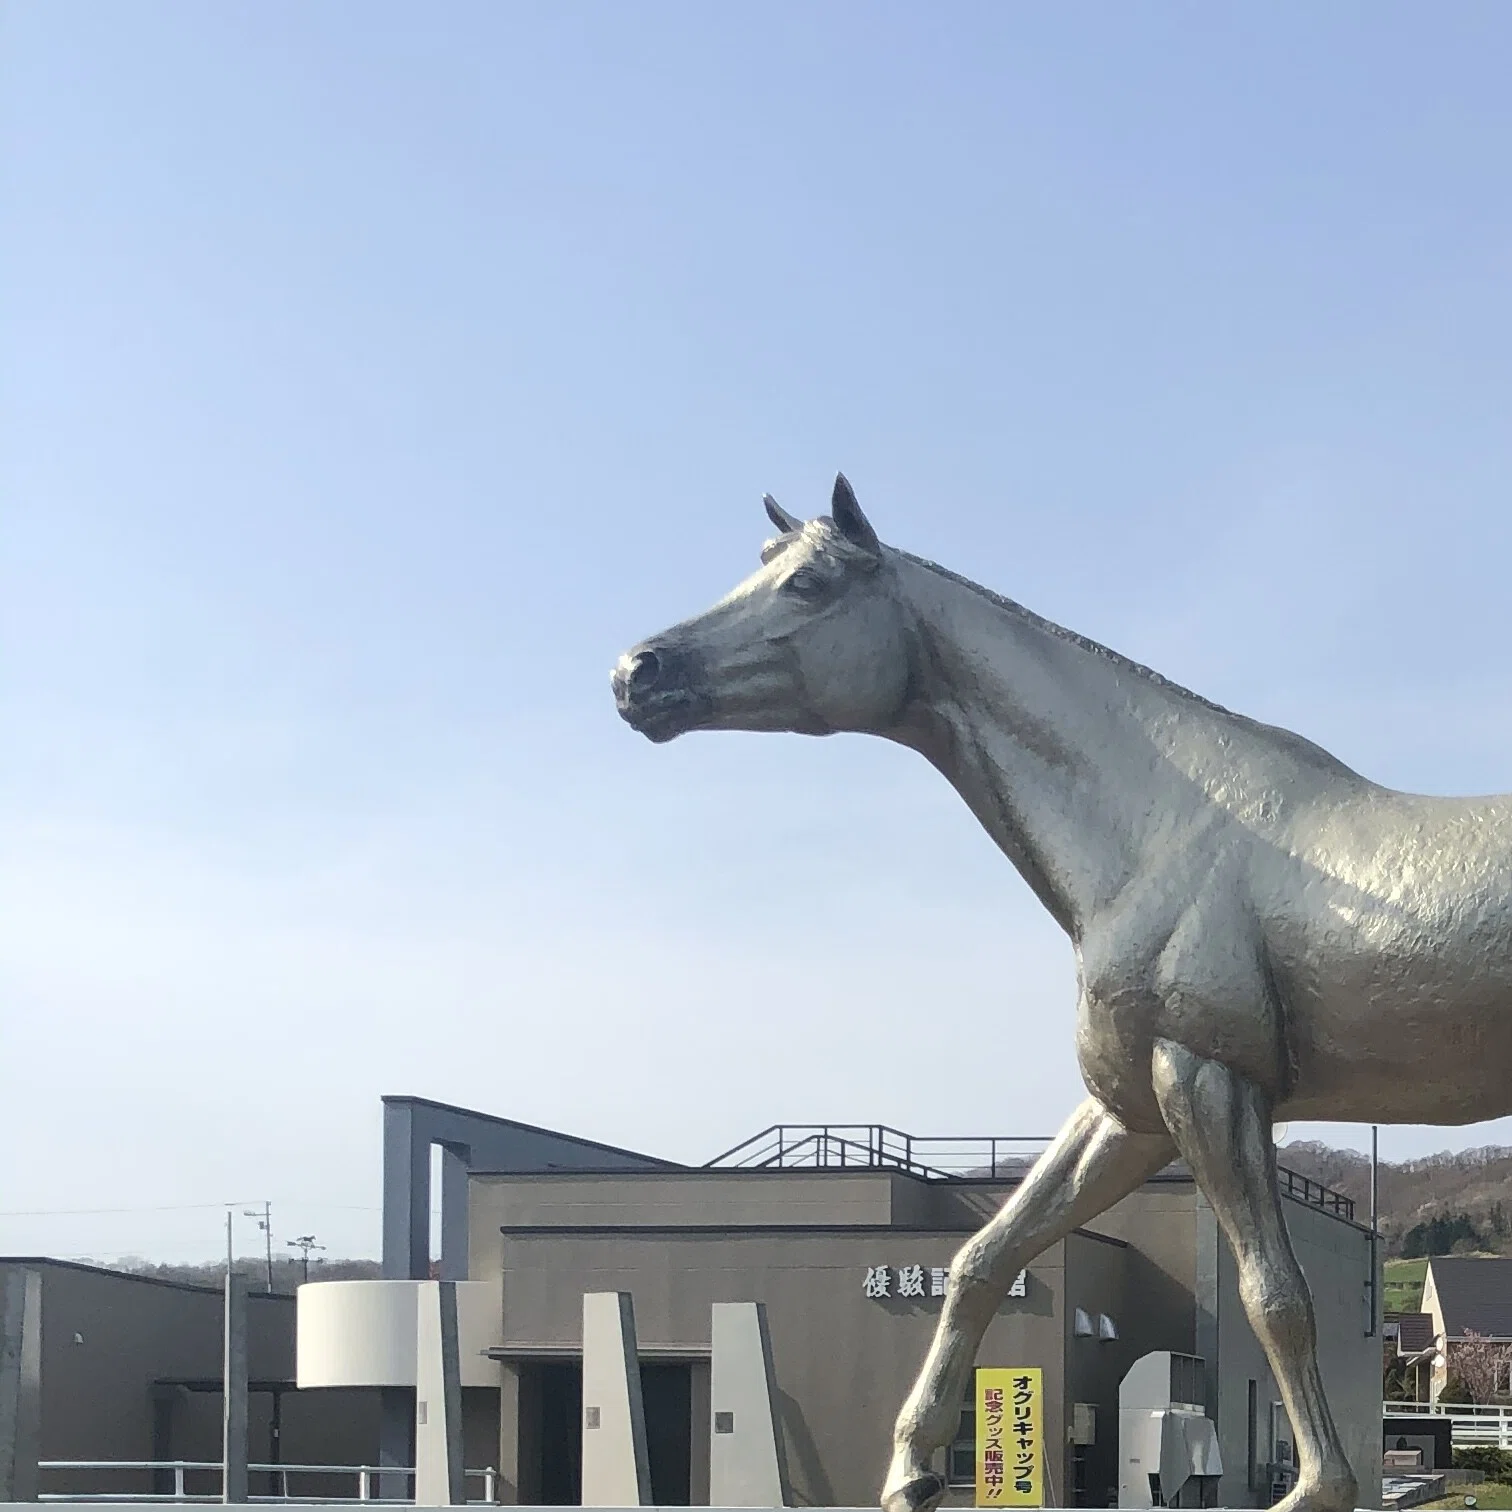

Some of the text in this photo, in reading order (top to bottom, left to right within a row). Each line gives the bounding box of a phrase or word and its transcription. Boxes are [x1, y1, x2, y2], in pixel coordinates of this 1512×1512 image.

[862, 1264, 1026, 1298] 優駿記
[1013, 1376, 1034, 1493] オグリキャップ号
